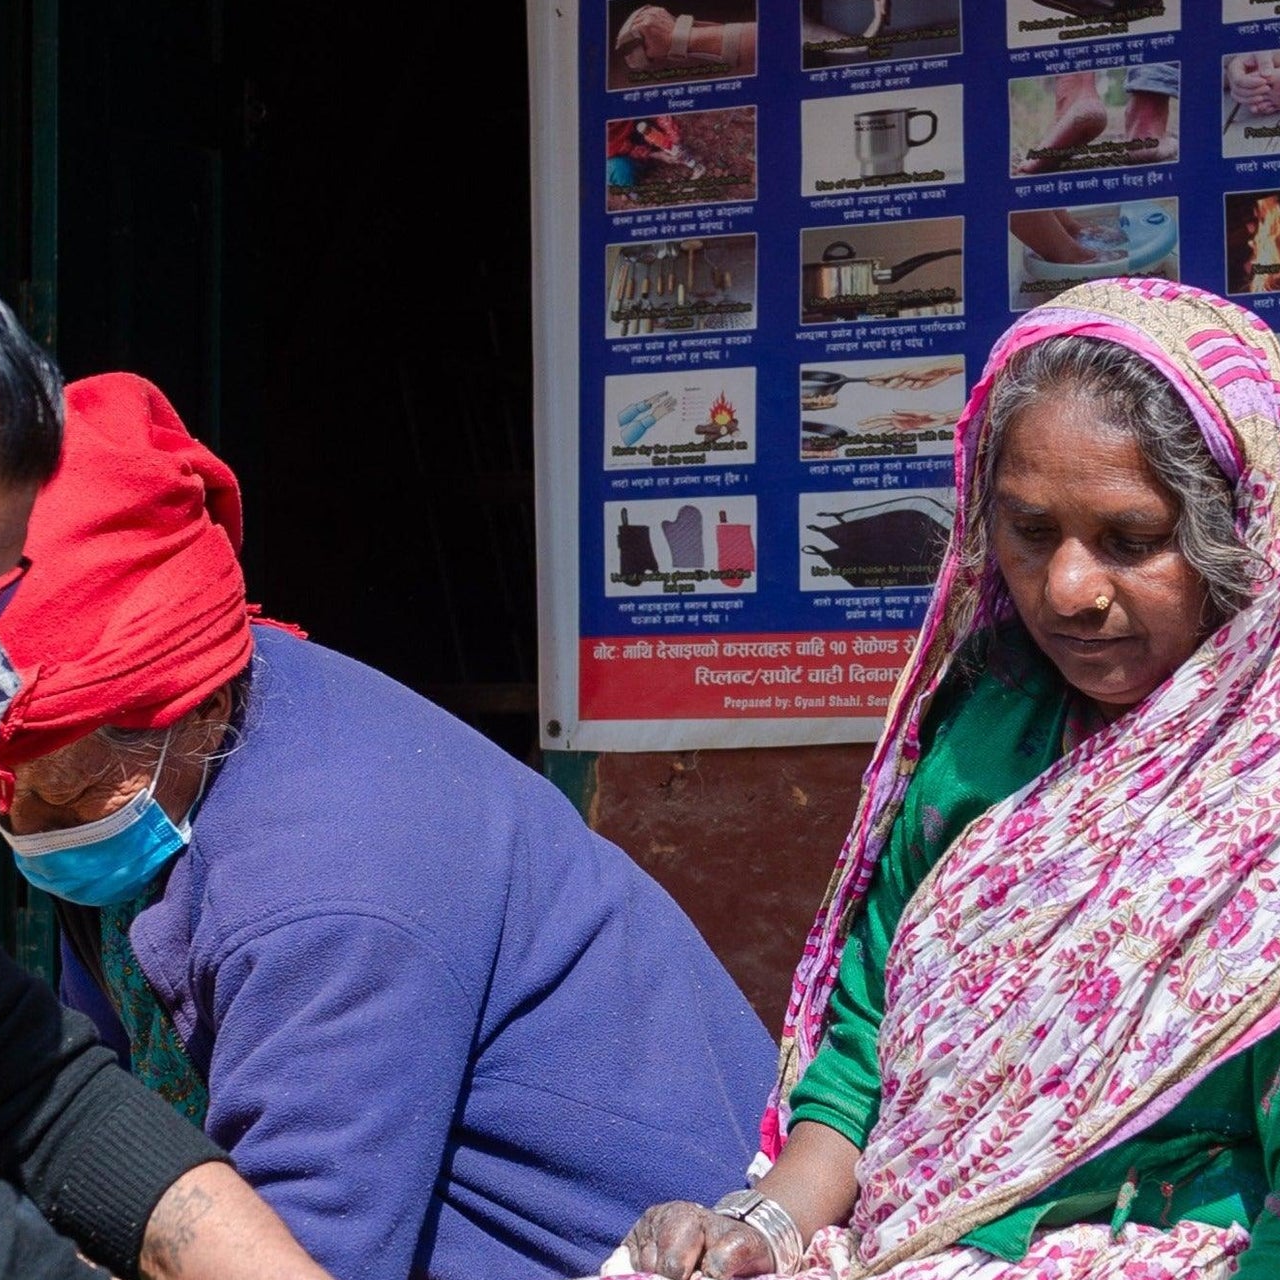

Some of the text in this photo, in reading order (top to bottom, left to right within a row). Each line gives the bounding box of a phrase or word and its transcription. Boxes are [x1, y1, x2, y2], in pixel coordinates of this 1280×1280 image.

[622, 640, 653, 660] माथि
[656, 638, 719, 660] देखाइएको
[829, 639, 847, 656] १०
[723, 694, 773, 711] Prepared
[775, 695, 792, 710] by:
[794, 694, 826, 710] Gyani
